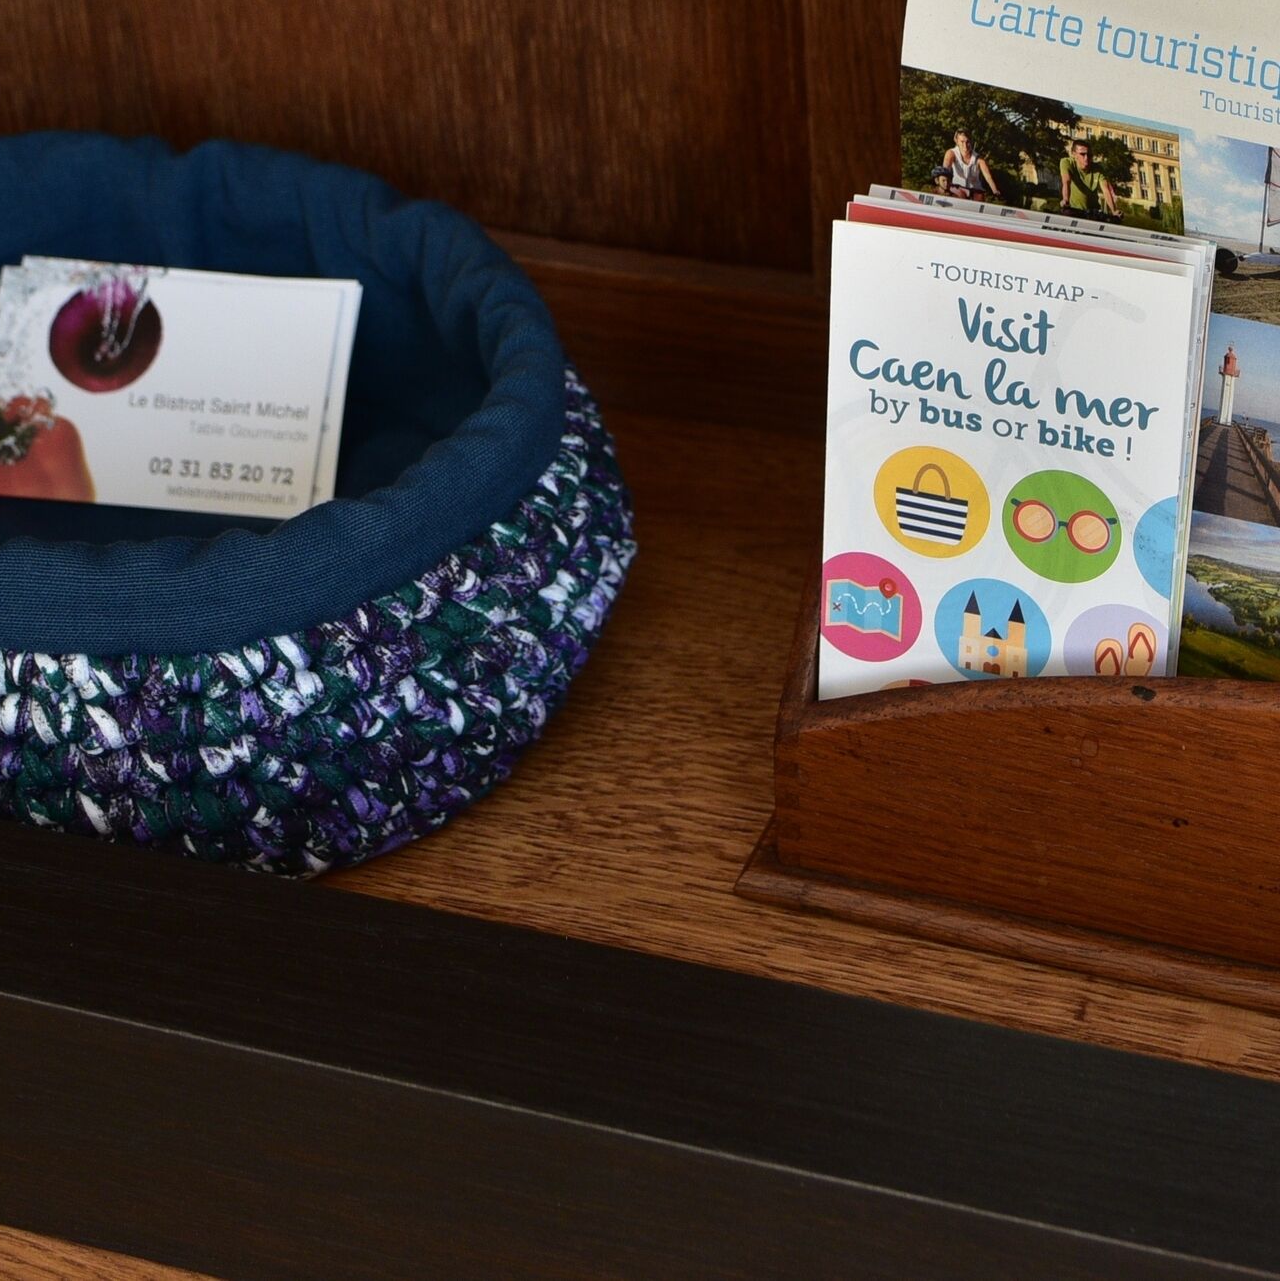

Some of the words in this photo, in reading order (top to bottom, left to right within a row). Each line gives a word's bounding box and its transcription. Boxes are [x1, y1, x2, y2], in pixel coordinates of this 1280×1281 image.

[930, 262, 1028, 293] TOURIST
[1034, 280, 1085, 302] MAP
[958, 297, 1055, 355] Visit
[849, 339, 972, 399] Caen
[984, 358, 1040, 409] la
[1055, 387, 1160, 430] mer
[128, 393, 148, 408] Le
[153, 393, 205, 414] Bistrot
[210, 398, 251, 416] Saint
[256, 401, 309, 419] Michel
[869, 389, 910, 423] by
[919, 398, 982, 432] bus
[992, 419, 1029, 440] or
[190, 421, 224, 436] Table
[148, 457, 172, 475] 02
[179, 459, 200, 477] 31
[209, 461, 234, 480] 83
[239, 464, 264, 483] 20
[272, 467, 294, 485] 72
